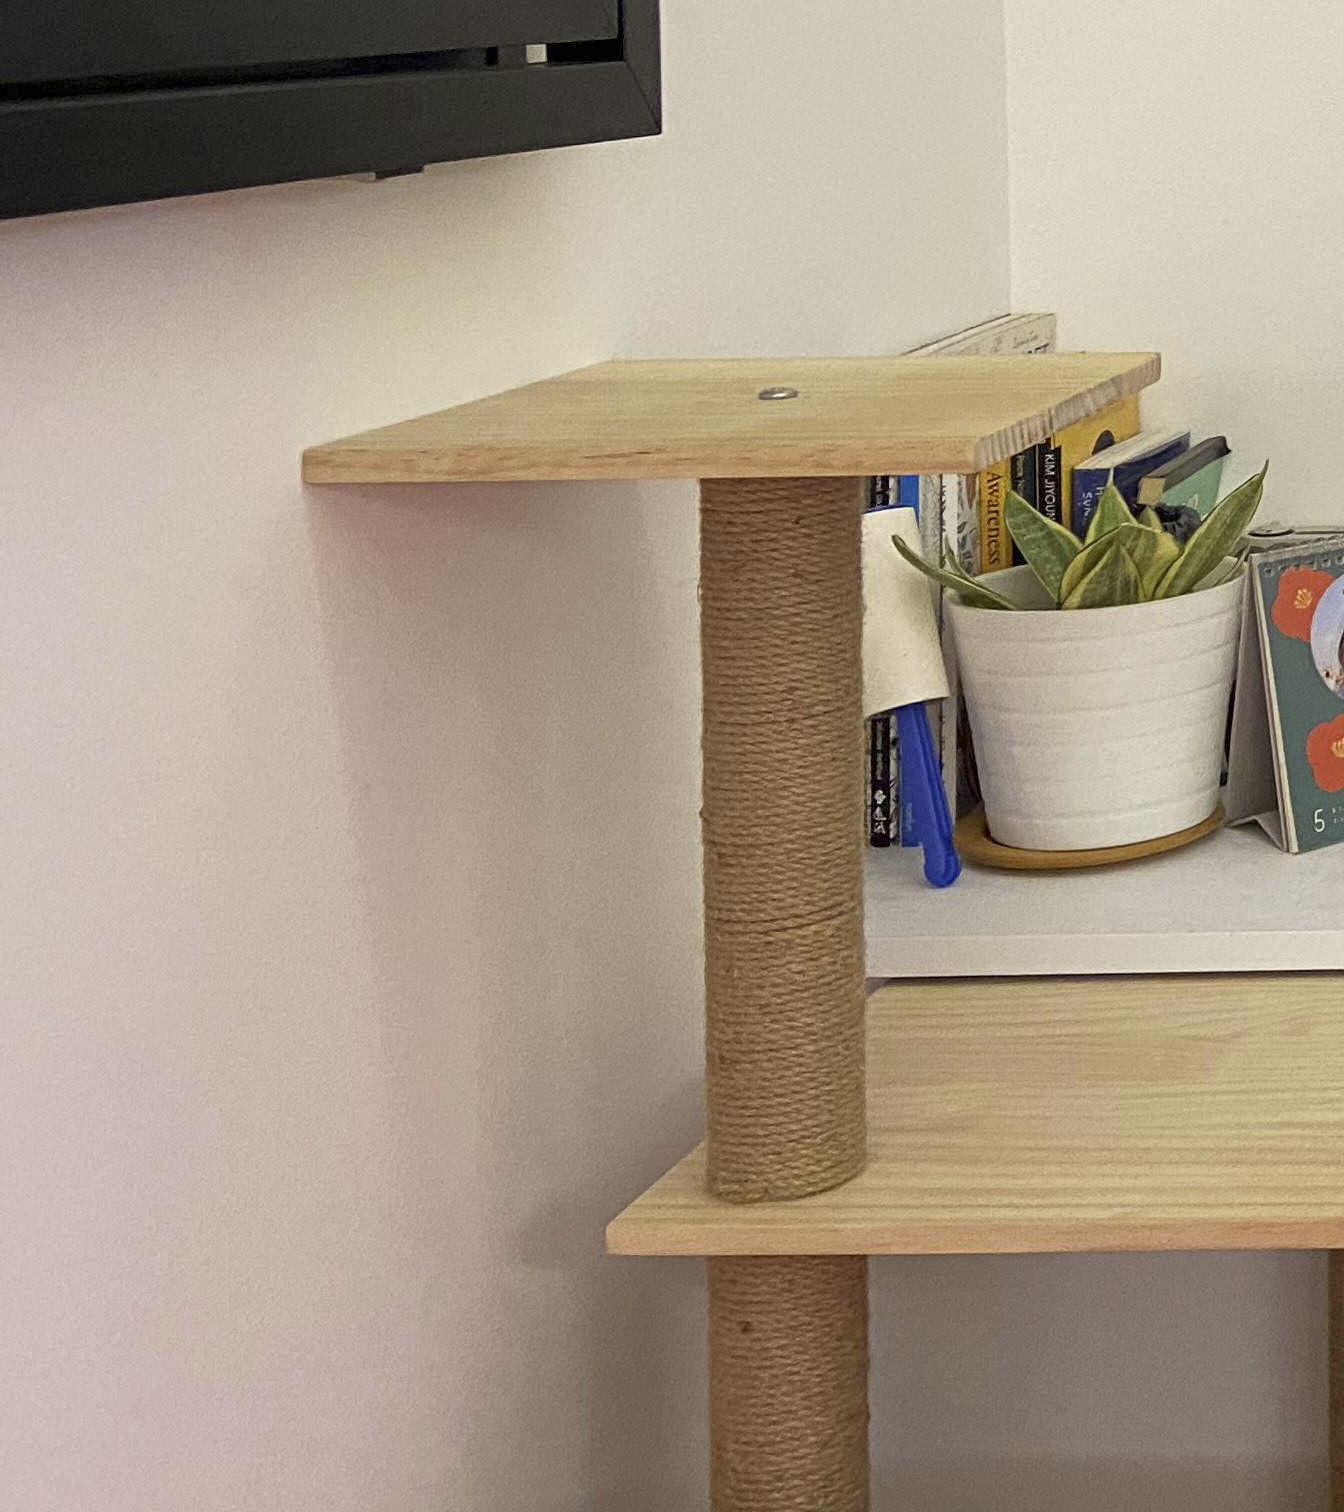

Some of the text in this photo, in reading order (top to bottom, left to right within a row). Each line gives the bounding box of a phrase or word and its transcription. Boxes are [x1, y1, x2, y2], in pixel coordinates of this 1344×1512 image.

[986, 472, 1002, 565] Awareness
[1044, 453, 1056, 522] KIM JIYOUN
[1314, 808, 1325, 833] 5
